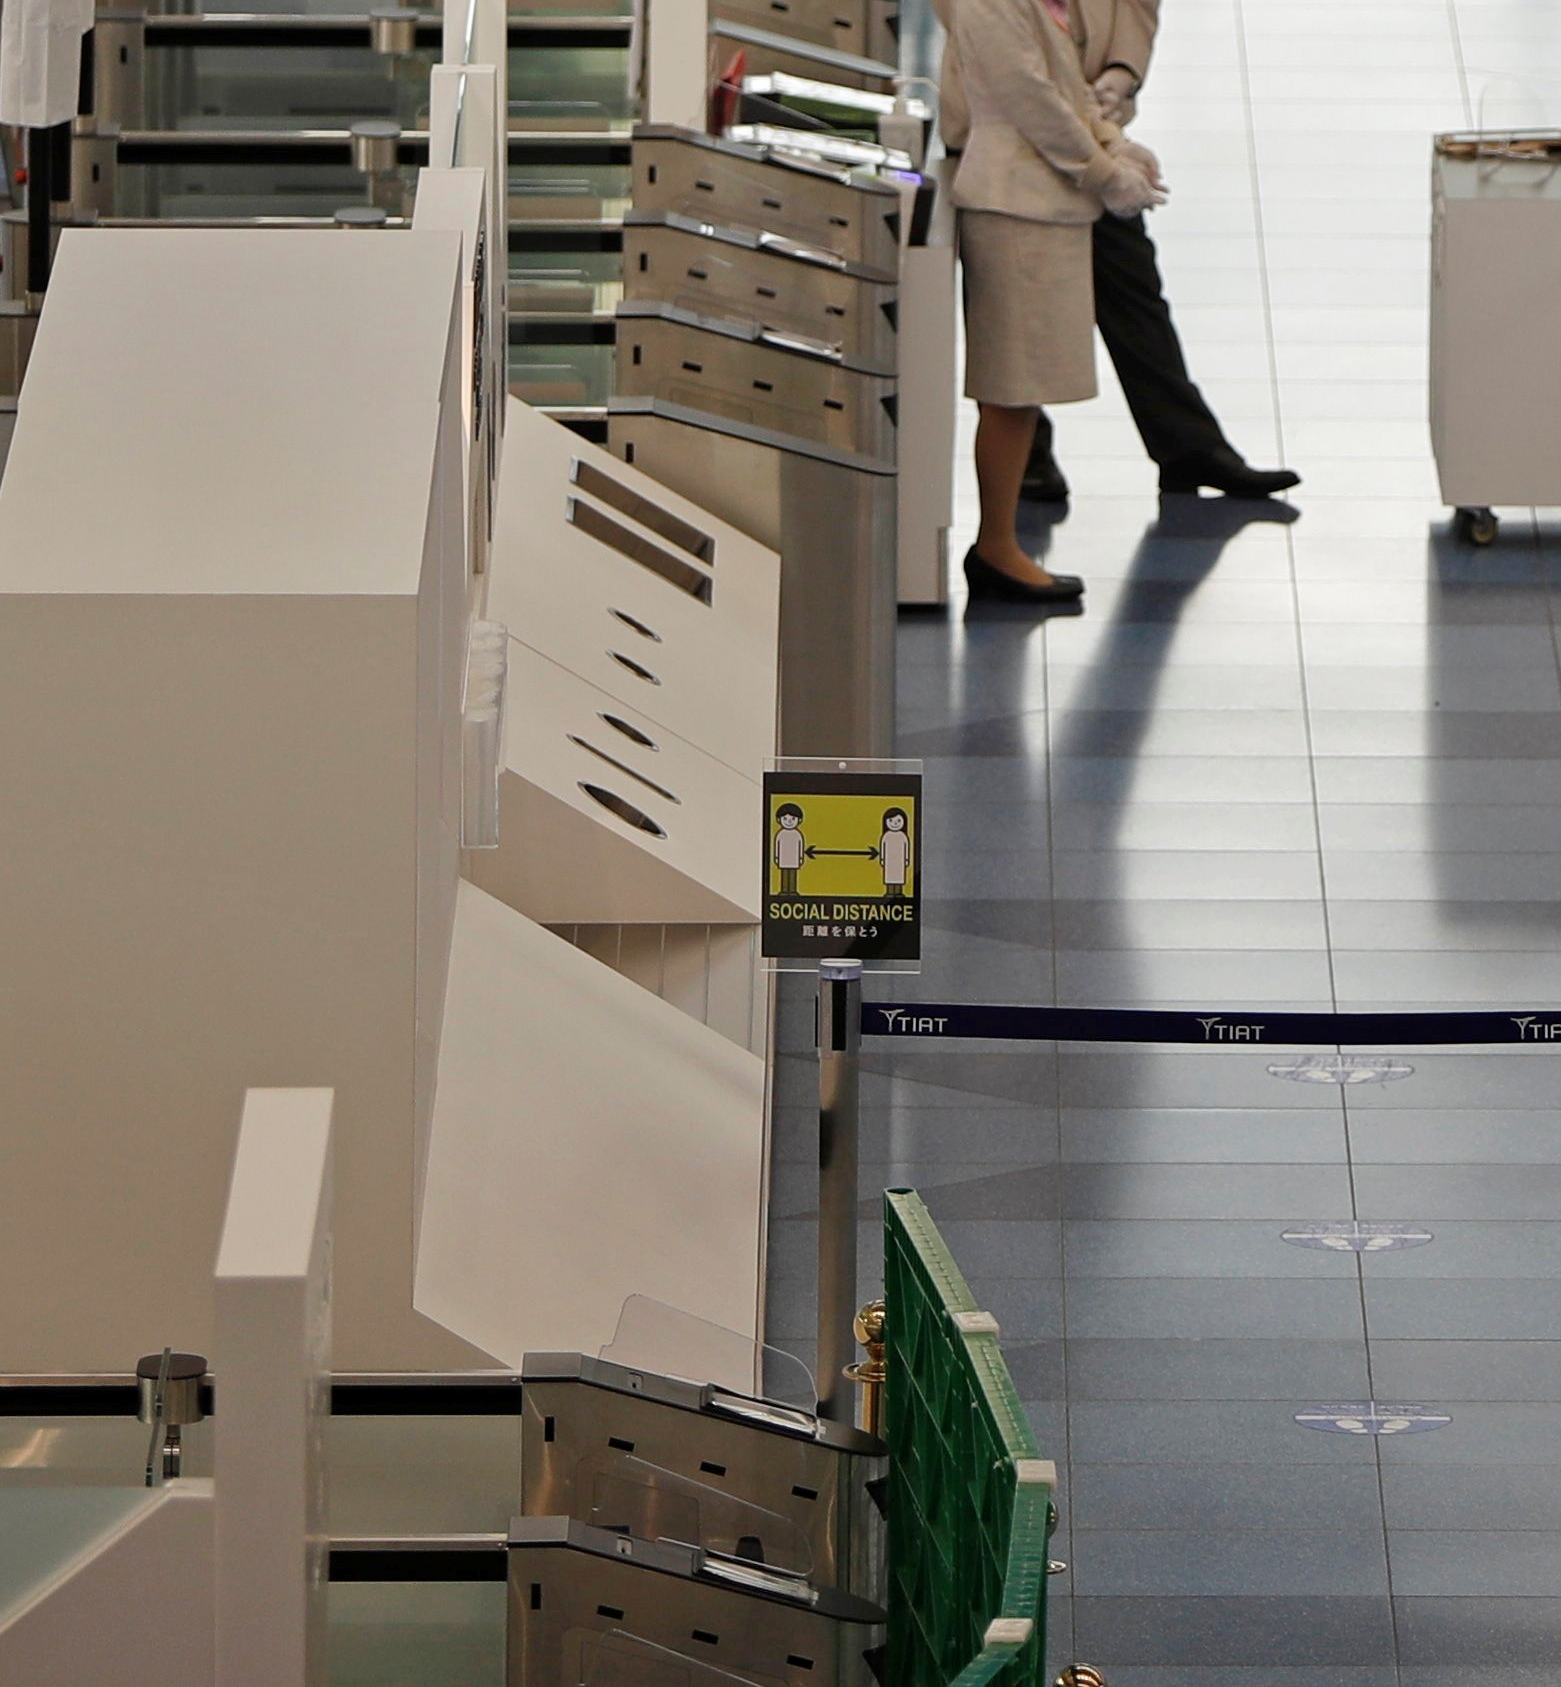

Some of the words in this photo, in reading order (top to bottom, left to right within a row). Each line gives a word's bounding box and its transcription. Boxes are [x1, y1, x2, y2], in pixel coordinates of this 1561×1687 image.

[769, 903, 830, 920] SOCIAL
[832, 904, 914, 922] DISTANCE
[802, 924, 878, 938] 距離を保とう
[895, 1015, 949, 1032] TIAT
